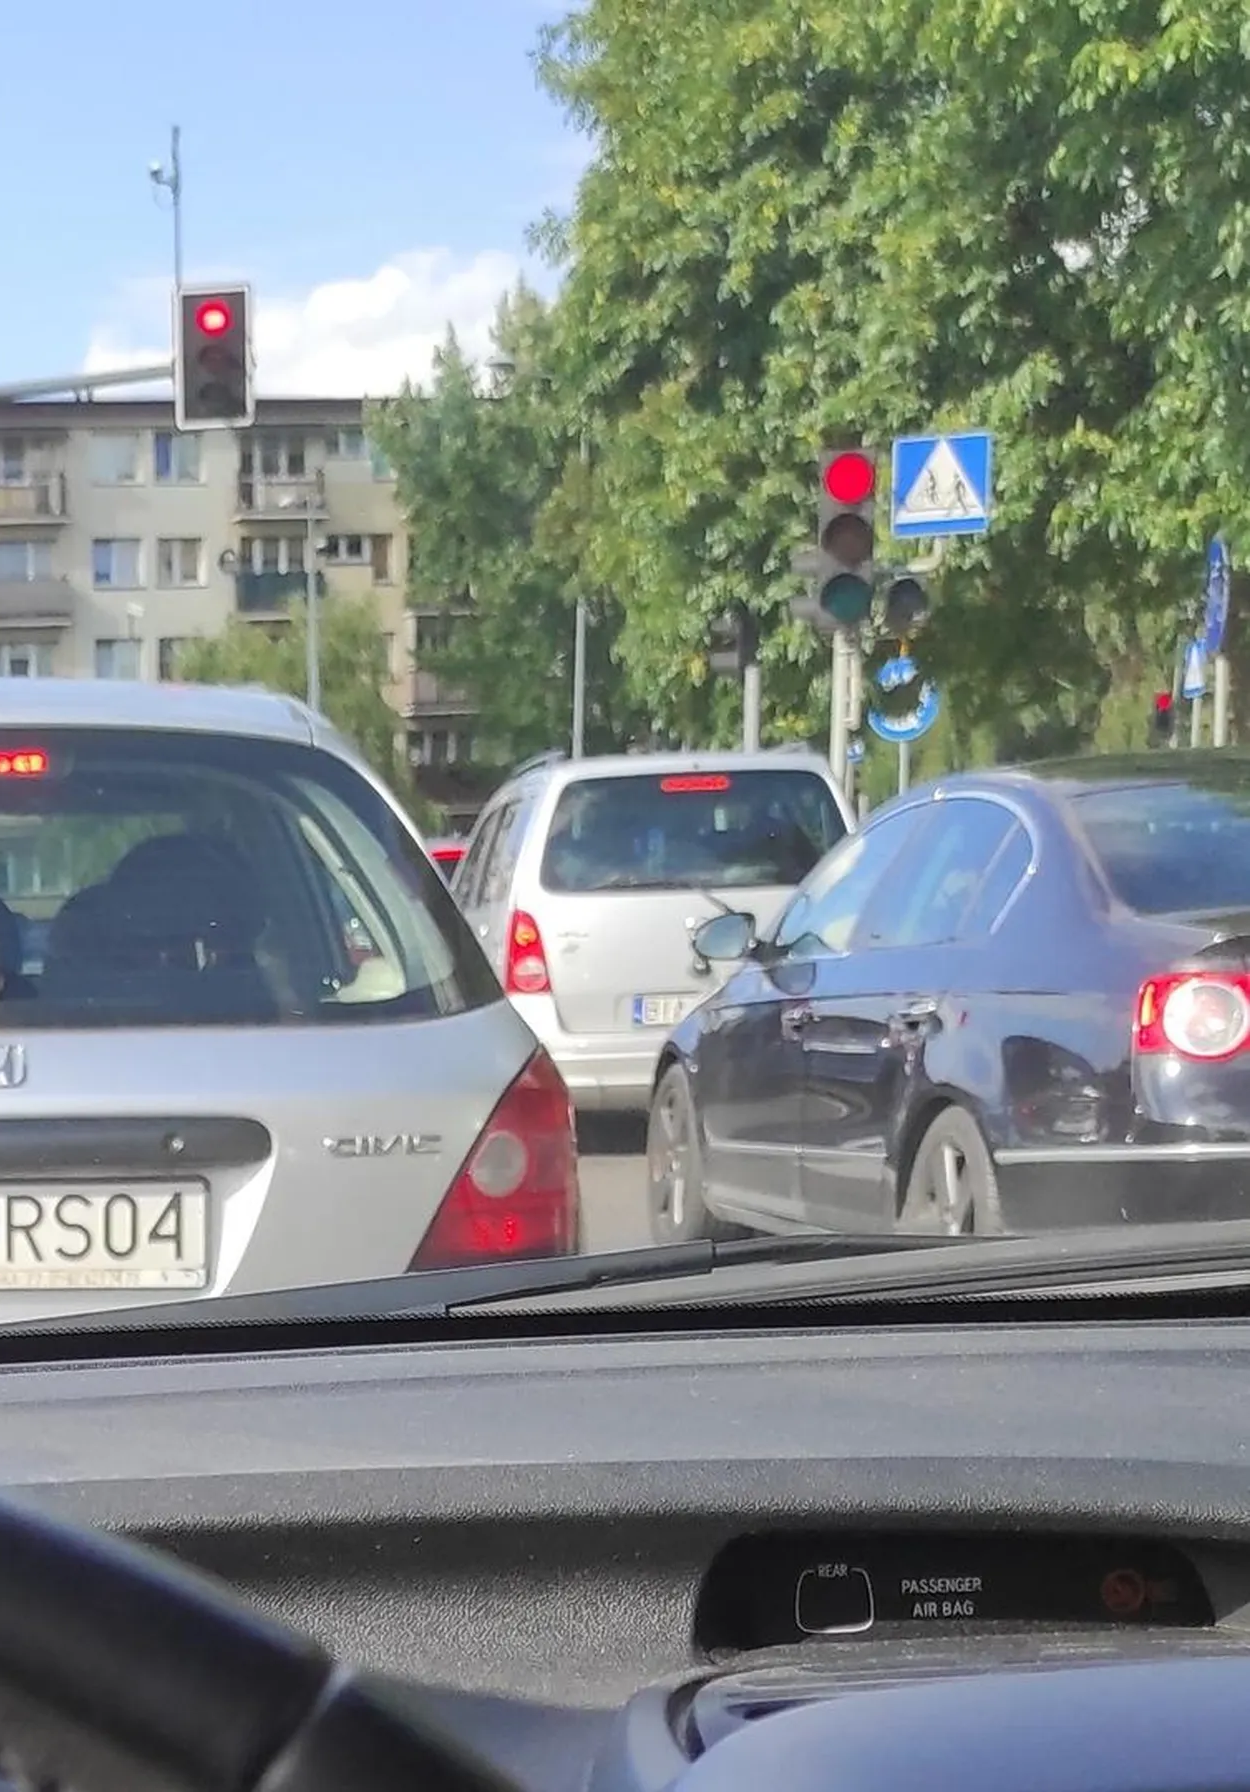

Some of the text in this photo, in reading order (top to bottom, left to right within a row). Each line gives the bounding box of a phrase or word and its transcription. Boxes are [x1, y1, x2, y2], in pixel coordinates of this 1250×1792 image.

[6, 1192, 185, 1263] RS04
[817, 1563, 849, 1577] REAR
[901, 1577, 983, 1594] PASSENGER
[912, 1601, 975, 1618] AIR BAG
